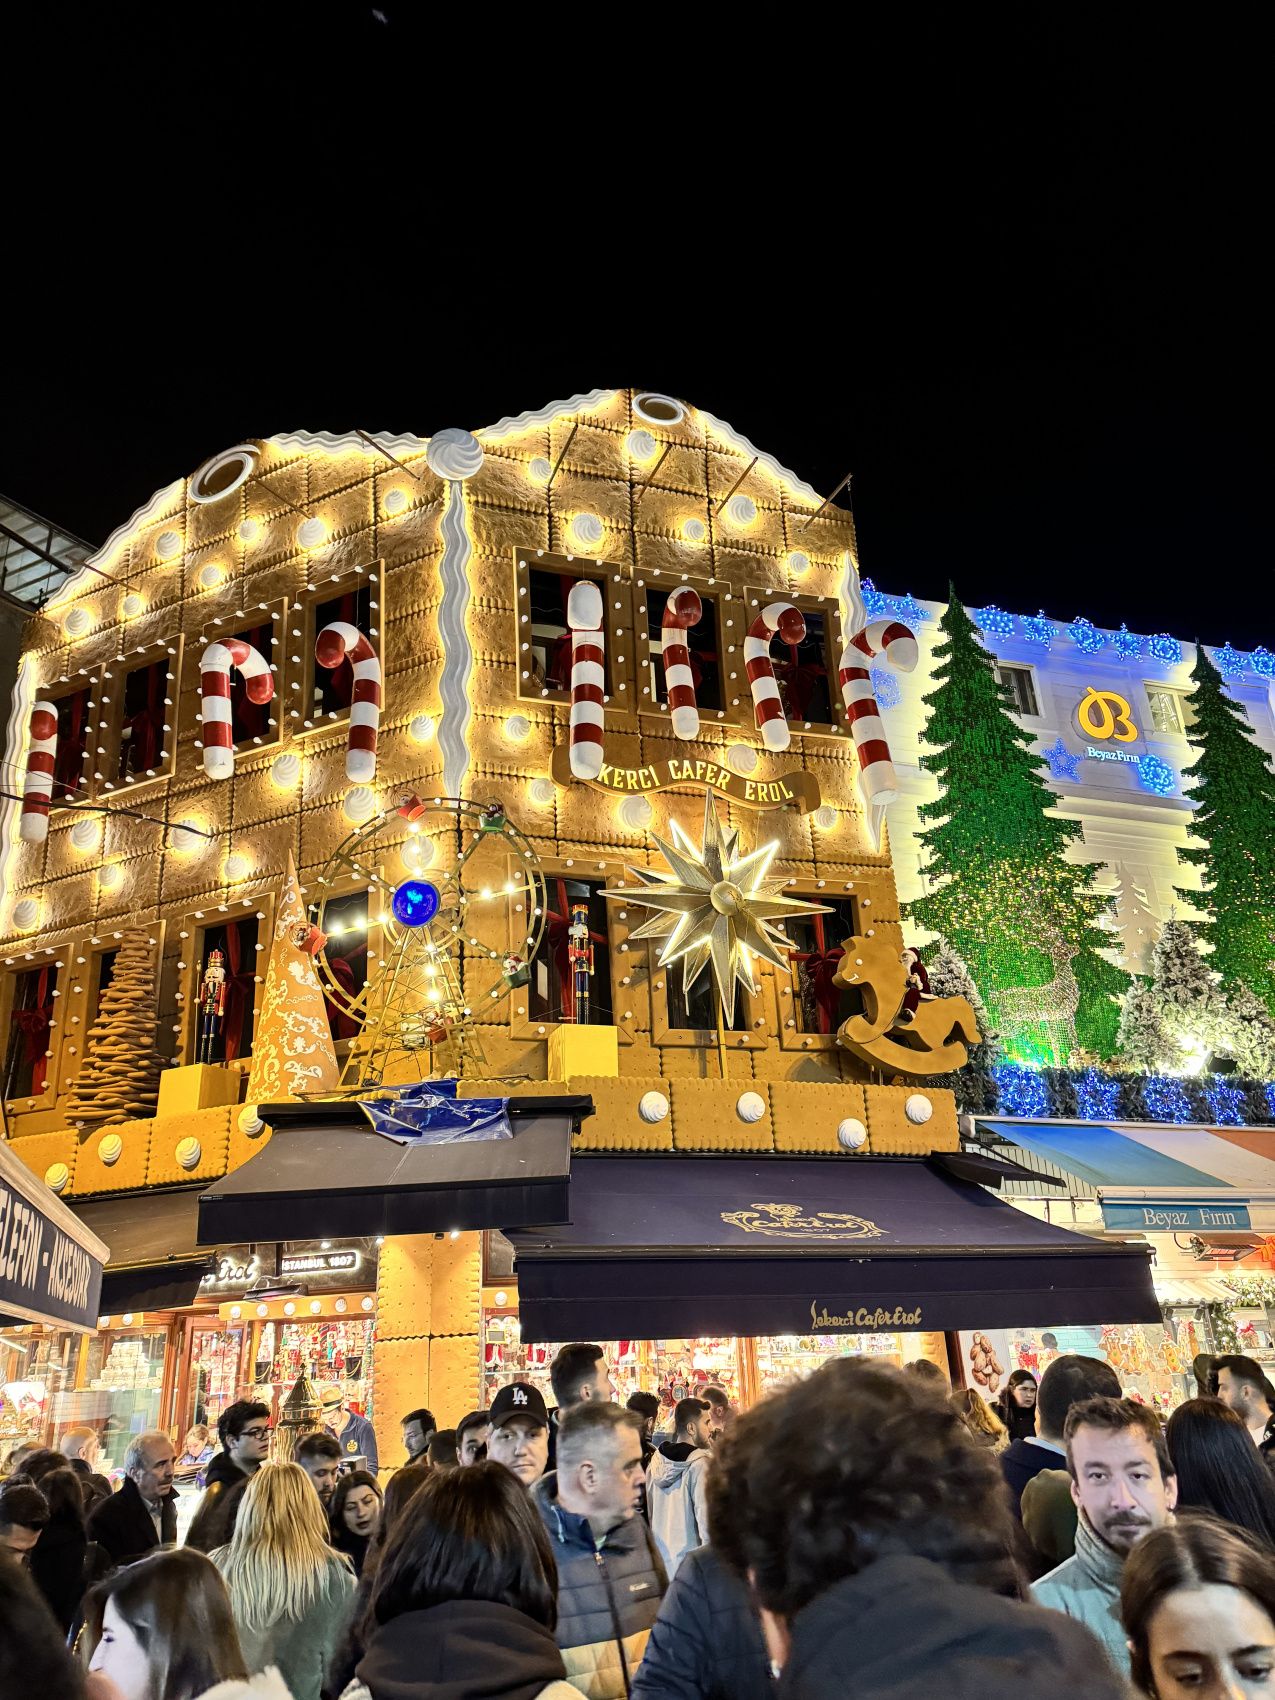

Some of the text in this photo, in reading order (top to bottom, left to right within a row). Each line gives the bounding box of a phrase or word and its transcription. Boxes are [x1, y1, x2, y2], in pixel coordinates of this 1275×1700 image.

[596, 759, 794, 802] KERCI CAFER EROL
[1142, 1208, 1190, 1230] Beyaz
[512, 1387, 528, 1405] LA
